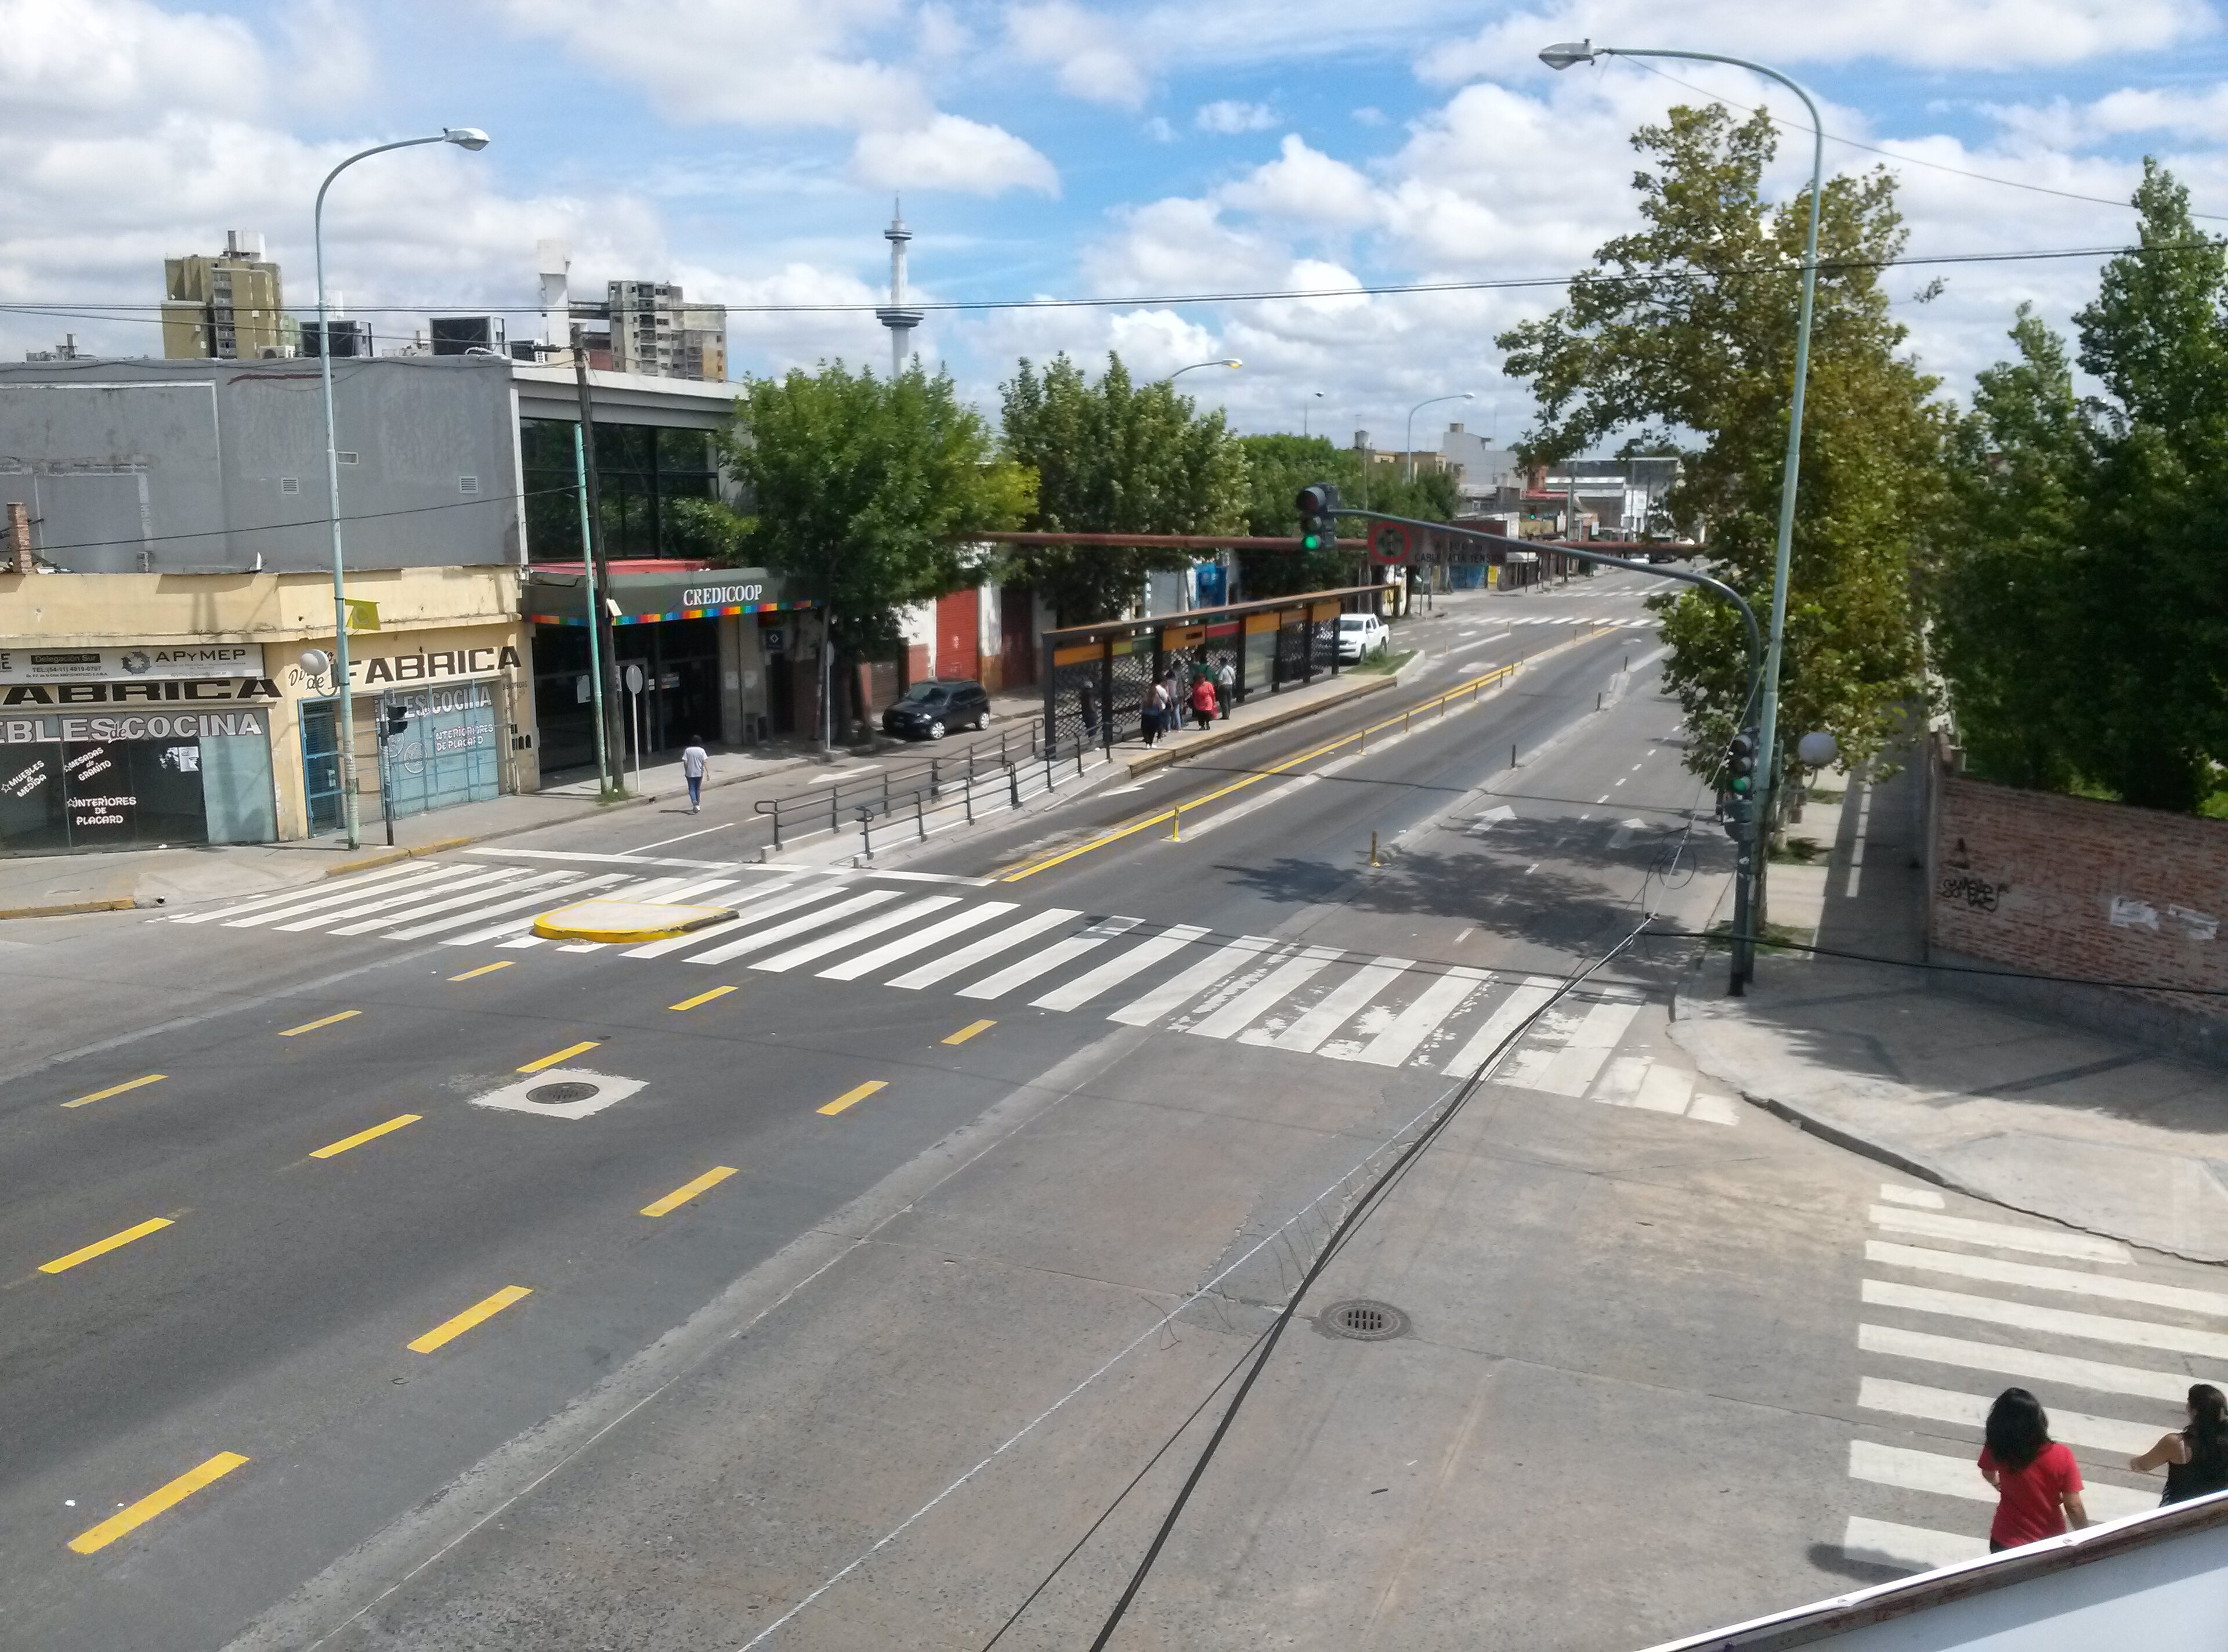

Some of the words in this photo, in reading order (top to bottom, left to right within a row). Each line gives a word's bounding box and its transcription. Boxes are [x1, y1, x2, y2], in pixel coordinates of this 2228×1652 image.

[683, 584, 762, 606] CREDICOOP
[121, 713, 263, 740] COCINA
[68, 747, 104, 769] MESADAS
[8, 760, 45, 786] MUEBLES
[78, 760, 112, 782] GRANITO
[16, 773, 47, 797] MEDIDA
[73, 795, 137, 808] INTERIORES
[75, 815, 124, 826] PLACARD
